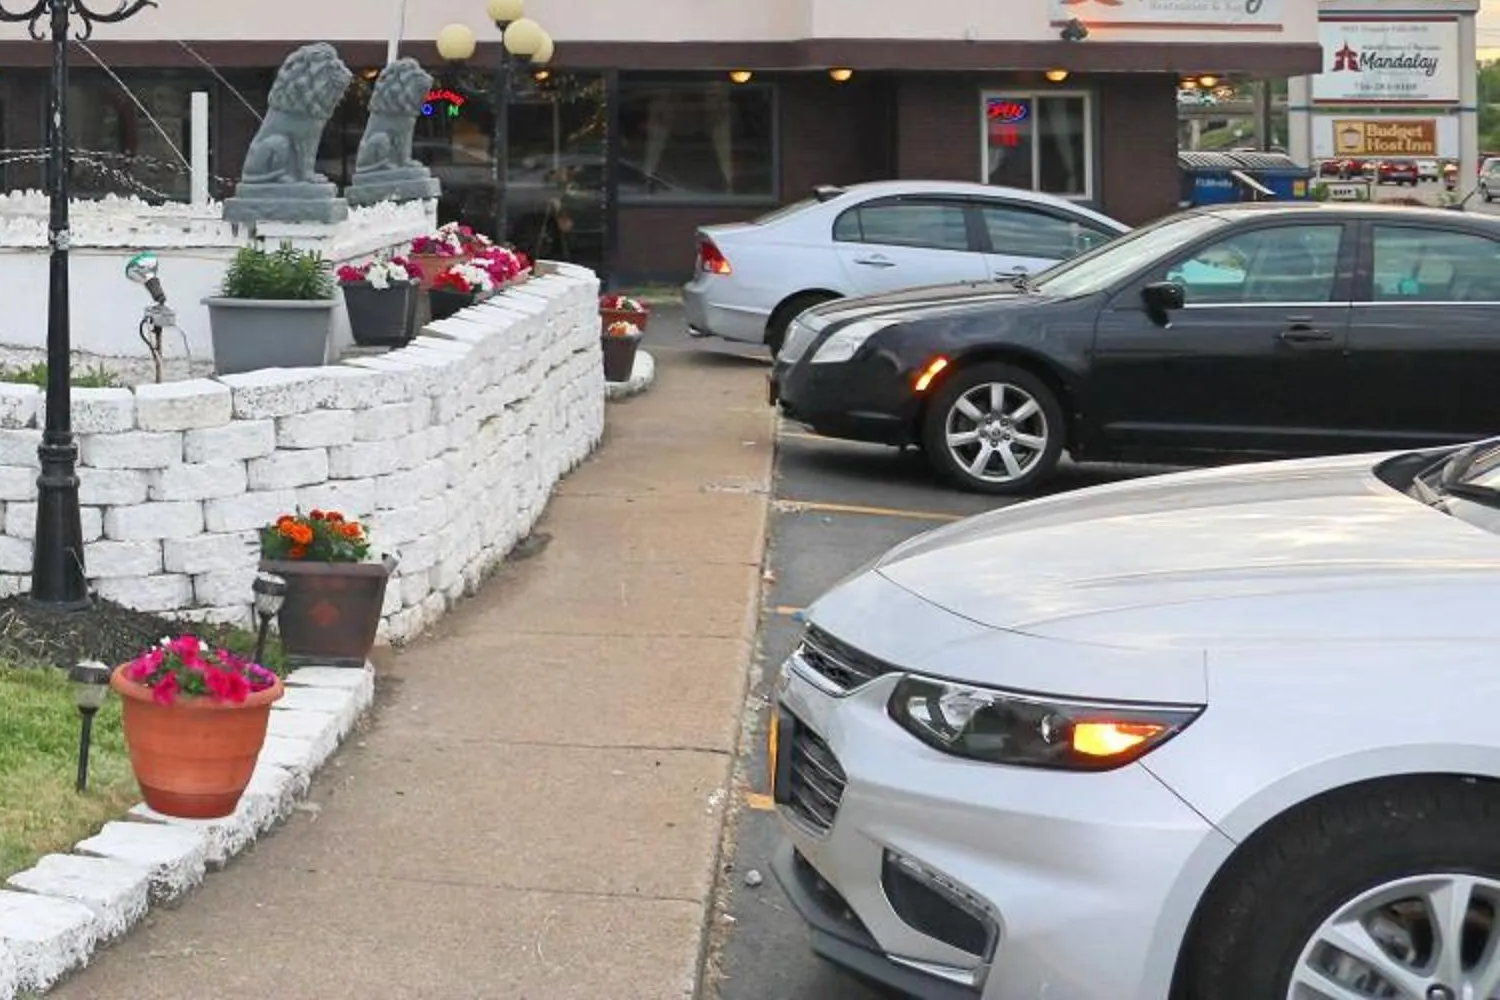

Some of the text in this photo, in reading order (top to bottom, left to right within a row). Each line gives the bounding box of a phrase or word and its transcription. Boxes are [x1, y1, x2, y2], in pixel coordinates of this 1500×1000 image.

[1359, 50, 1438, 77] Mandalay
[1367, 123, 1423, 140] Budget
[1367, 138, 1432, 152] Host Inn
